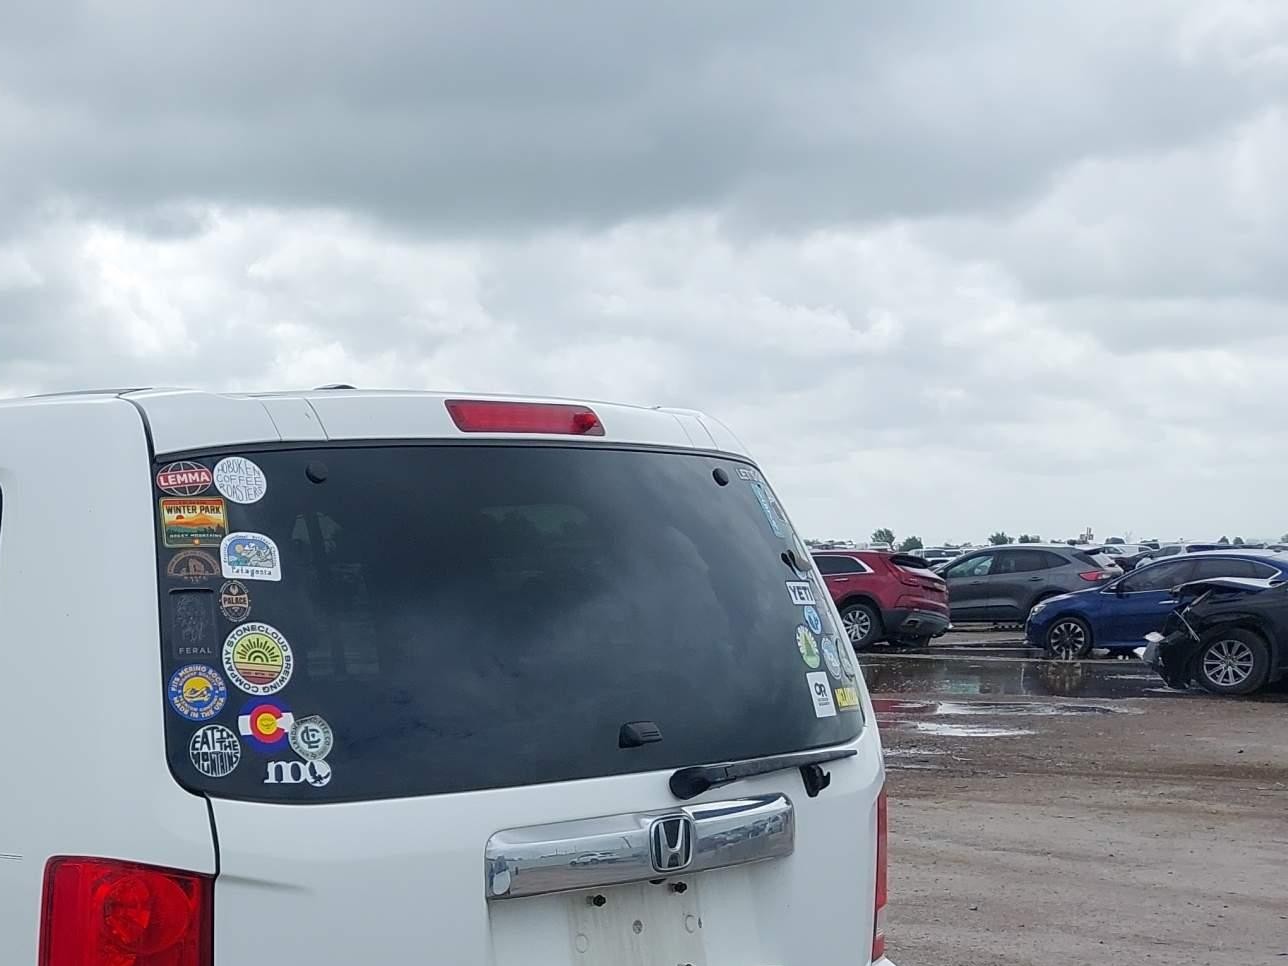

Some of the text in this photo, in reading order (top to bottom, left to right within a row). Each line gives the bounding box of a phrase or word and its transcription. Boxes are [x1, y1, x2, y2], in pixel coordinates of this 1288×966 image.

[159, 471, 211, 486] LEMMA
[216, 473, 263, 486] COFFEE
[218, 483, 264, 502] ROASTERS
[165, 504, 222, 515] WINTER PARK
[231, 566, 272, 578] Patagonia
[223, 596, 248, 605] PALACE
[788, 585, 813, 601] YETI
[226, 624, 290, 653] STONECLOUD
[178, 647, 212, 655] FERAL
[178, 664, 207, 677] MERINO
[207, 668, 226, 692] SOCKS
[224, 650, 261, 693] COMPANY
[261, 655, 292, 694] BREWING
[172, 696, 189, 715] MADE
[200, 708, 215, 718] THE
[213, 697, 226, 711] USA
[191, 726, 234, 751] EAT IN
[215, 740, 239, 751] THE
[191, 751, 240, 776] MOUNTAINS
